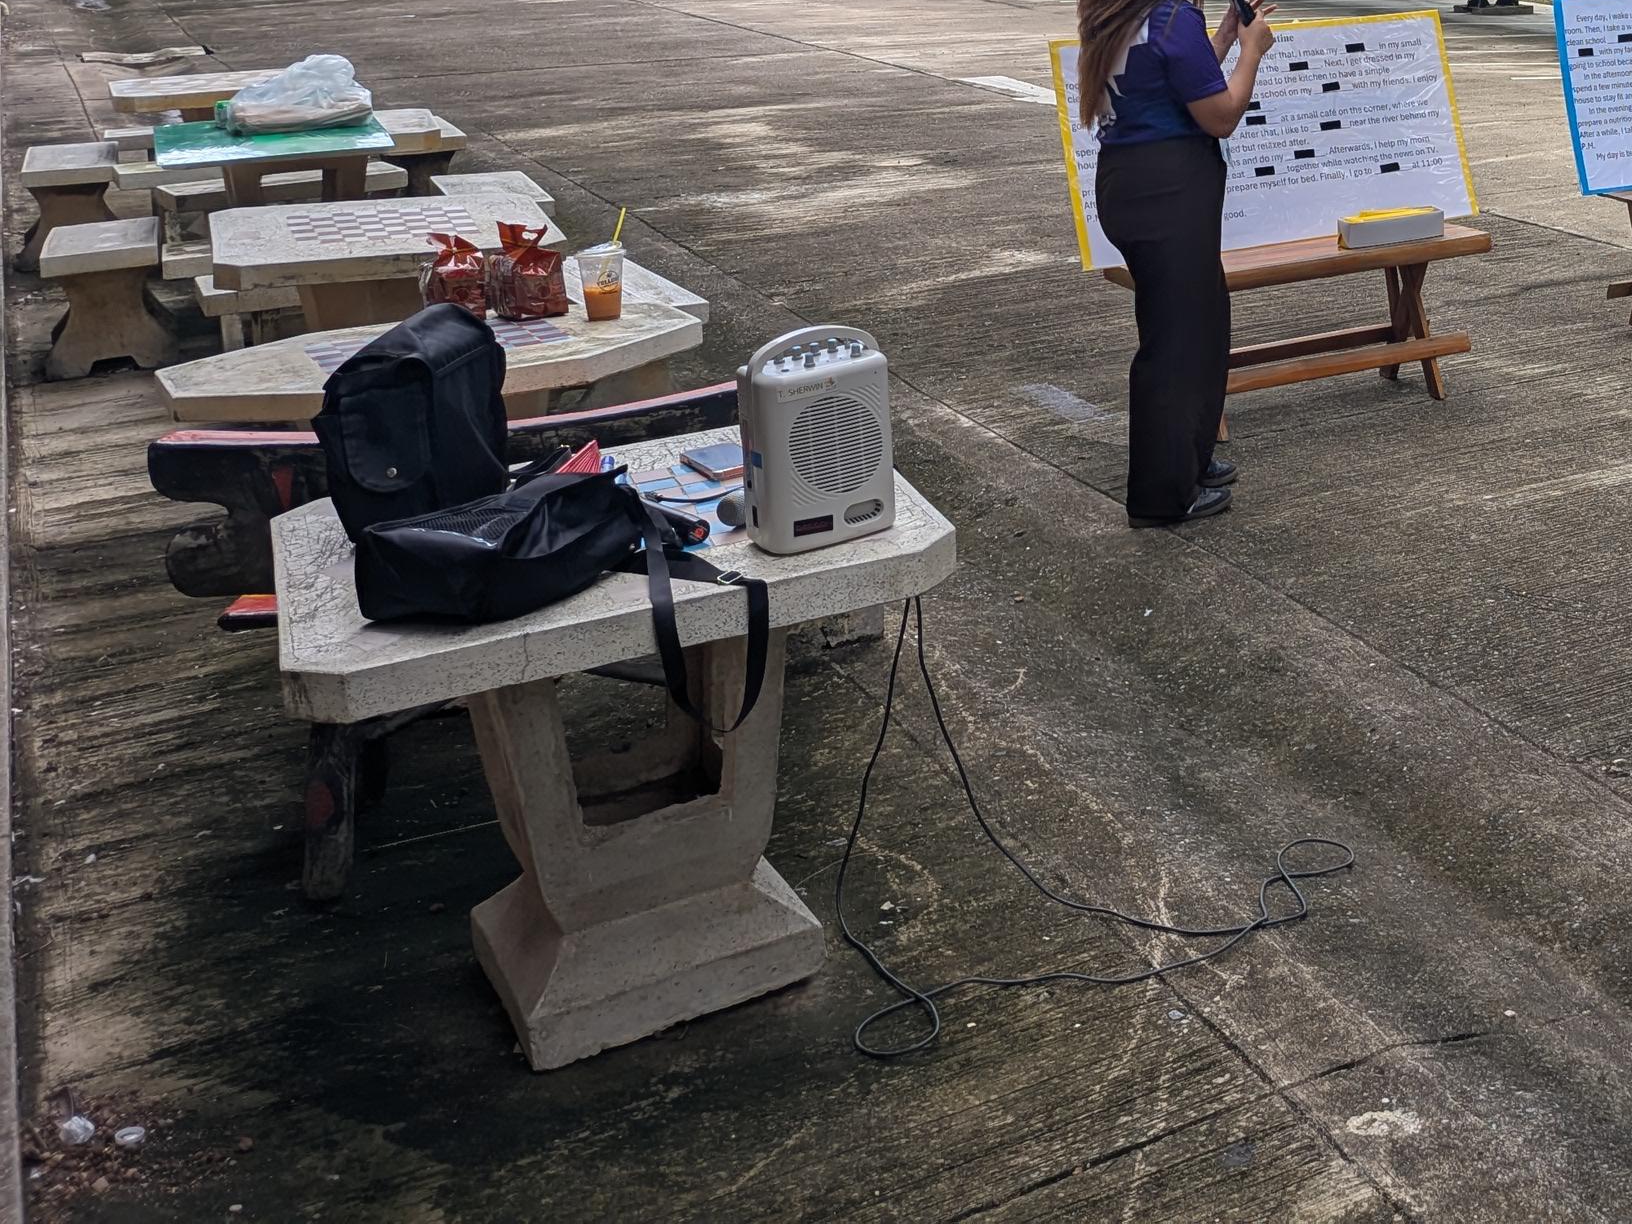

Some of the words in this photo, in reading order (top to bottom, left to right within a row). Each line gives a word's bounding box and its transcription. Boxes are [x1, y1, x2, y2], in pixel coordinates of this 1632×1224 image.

[1400, 38, 1422, 47] small
[1302, 48, 1325, 56] make
[1363, 53, 1394, 63] dressed
[1298, 72, 1328, 82] kitchen
[1338, 69, 1357, 78] have
[1364, 66, 1391, 77] simple
[1352, 80, 1369, 89] with
[1416, 74, 1438, 84] enjoy
[1260, 89, 1287, 98] school
[1296, 111, 1319, 120] small
[1319, 109, 1337, 118] café
[1392, 100, 1415, 109] where
[1382, 114, 1399, 123] river
[1400, 111, 1427, 121] behind
[1257, 140, 1287, 150] relaxed
[1378, 139, 1396, 150] help
[1242, 156, 1258, 165] and
[1286, 161, 1320, 174] together
[1320, 158, 1343, 168] while
[1343, 153, 1380, 166] watching
[1422, 158, 1444, 168] 11:00
[1226, 183, 1259, 194] prepare
[1259, 178, 1287, 190] myself
[788, 382, 823, 396] SHERWIN
